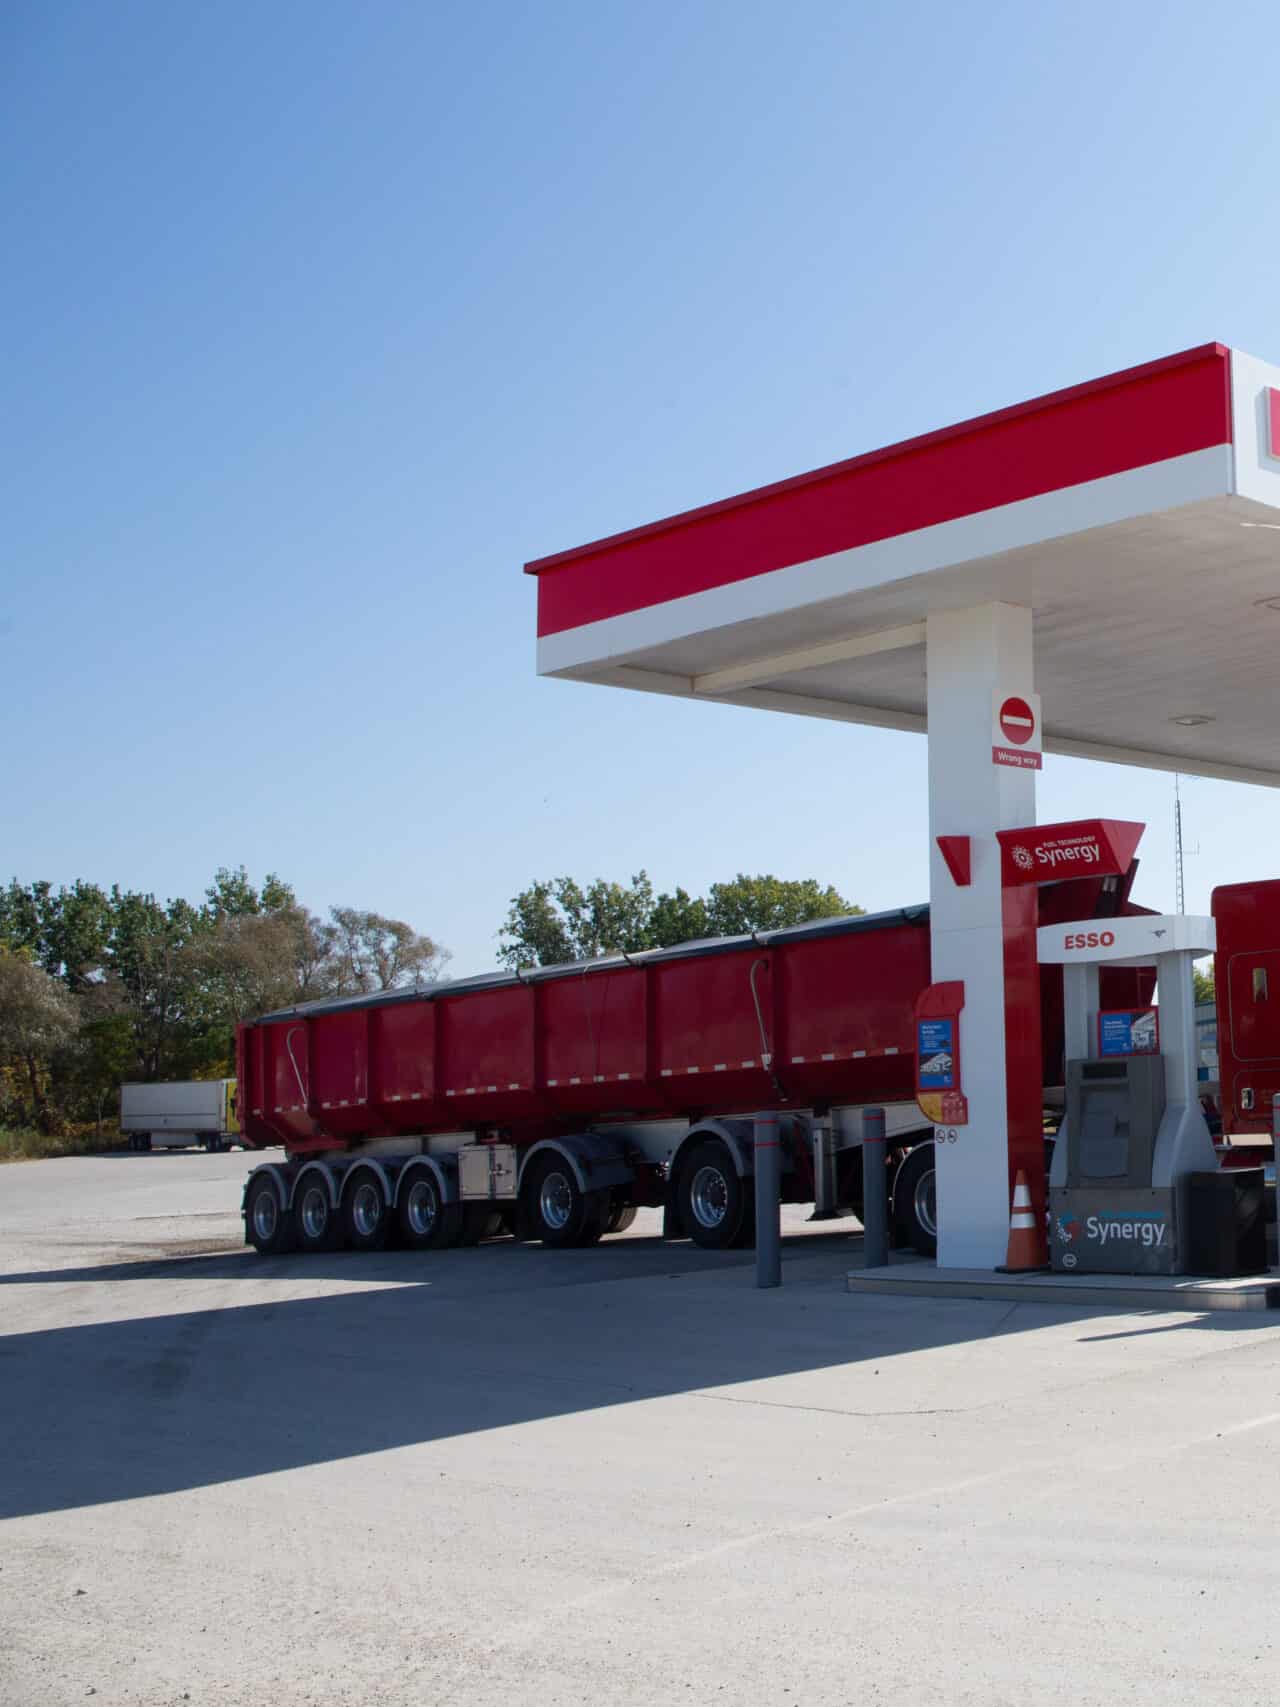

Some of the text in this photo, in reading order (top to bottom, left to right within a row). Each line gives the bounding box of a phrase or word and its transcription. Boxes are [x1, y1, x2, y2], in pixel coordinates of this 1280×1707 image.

[998, 751, 1038, 767] Wrong way
[1035, 843, 1100, 867] Synergy
[1064, 931, 1115, 950] ESSO
[1086, 1216, 1166, 1246] Synergy
